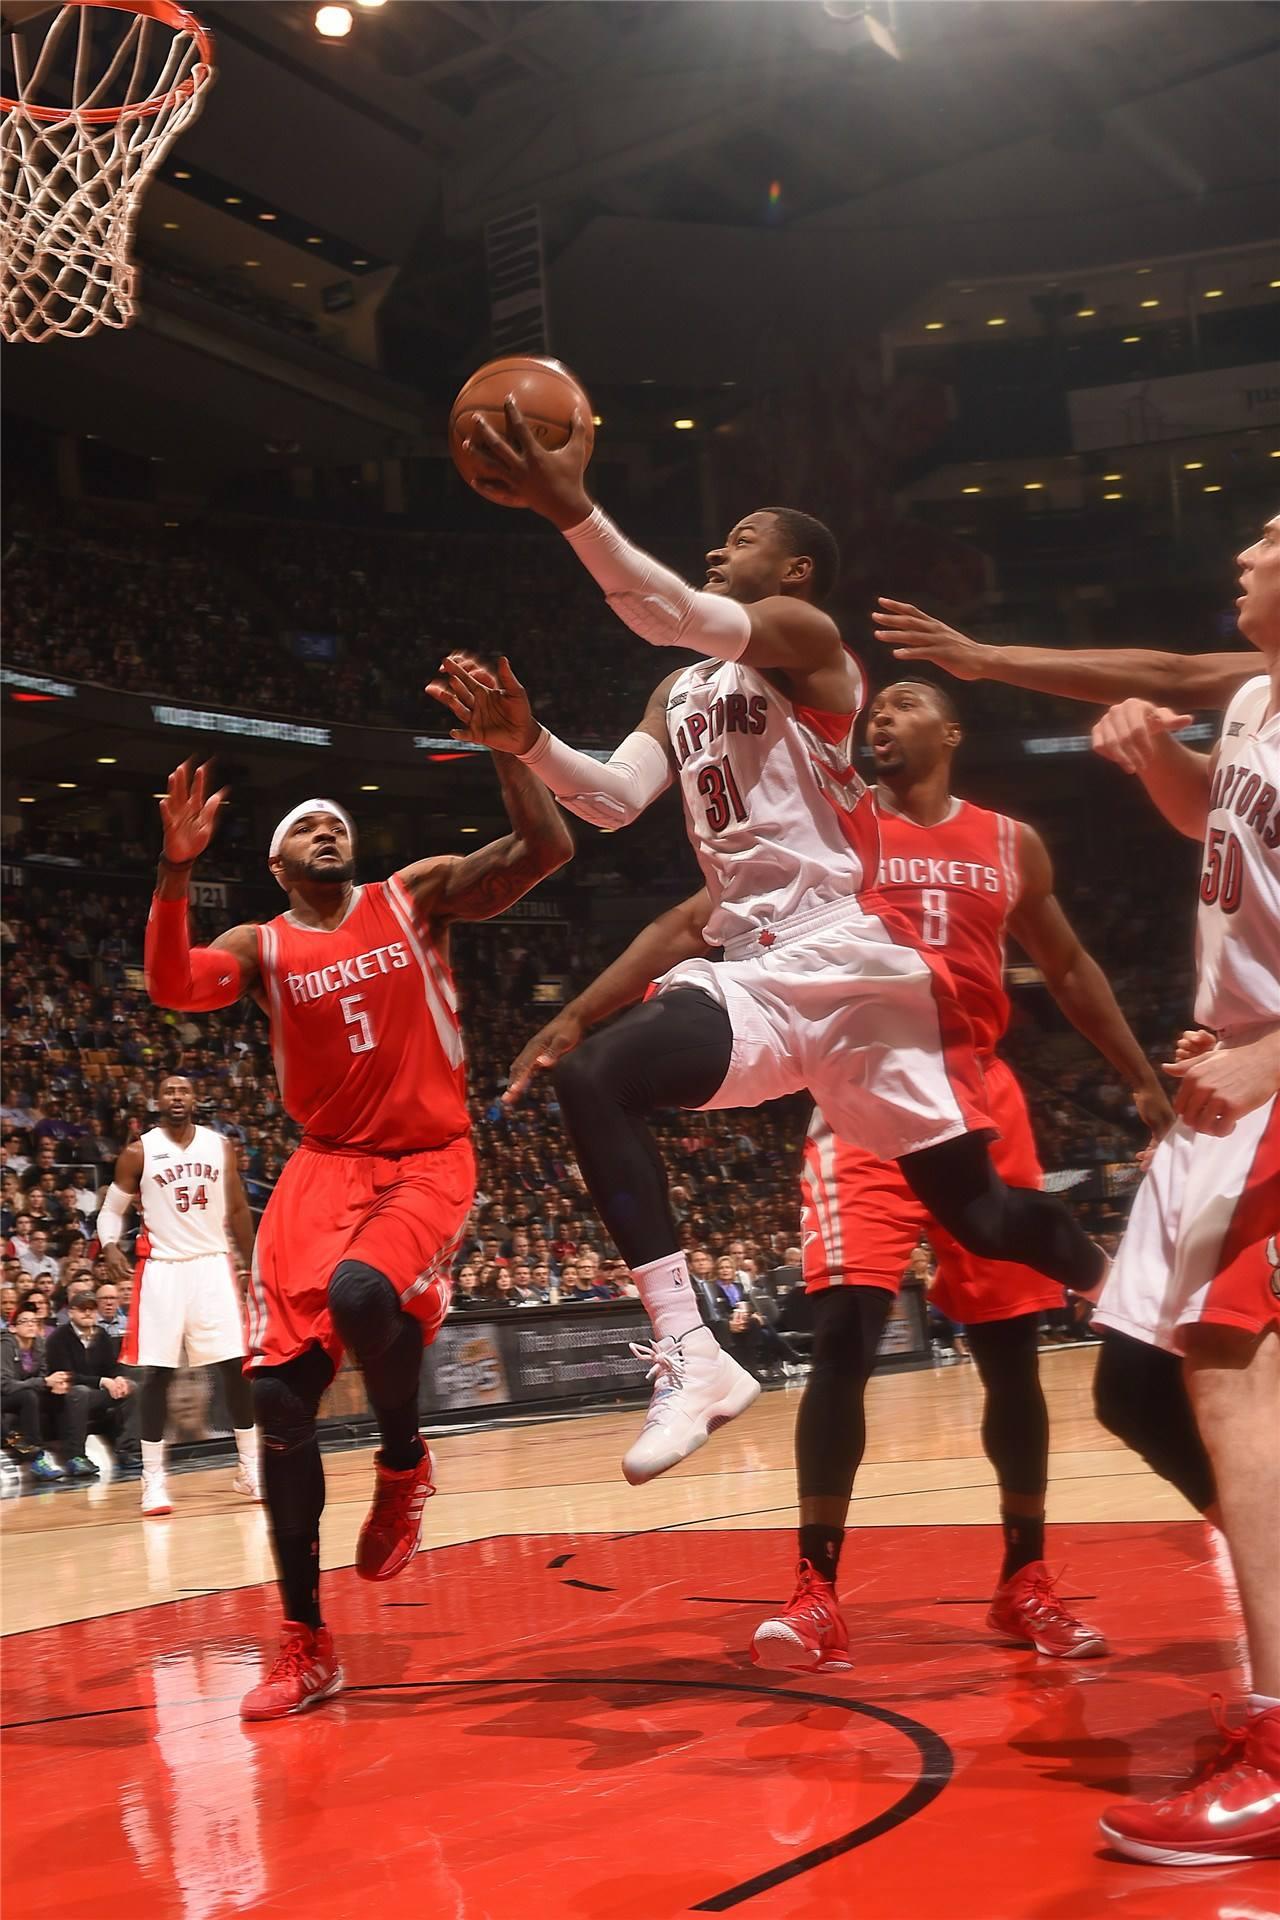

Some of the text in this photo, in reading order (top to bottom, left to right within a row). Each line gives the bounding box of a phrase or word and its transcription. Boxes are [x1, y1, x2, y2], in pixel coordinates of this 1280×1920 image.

[697, 754, 748, 833] 31
[1200, 827, 1242, 914] 50
[921, 887, 948, 946] 8
[282, 941, 410, 1006] ROCKETS
[339, 992, 377, 1054] 5
[152, 1163, 219, 1188] RAPTORS
[175, 1185, 208, 1213] 54
